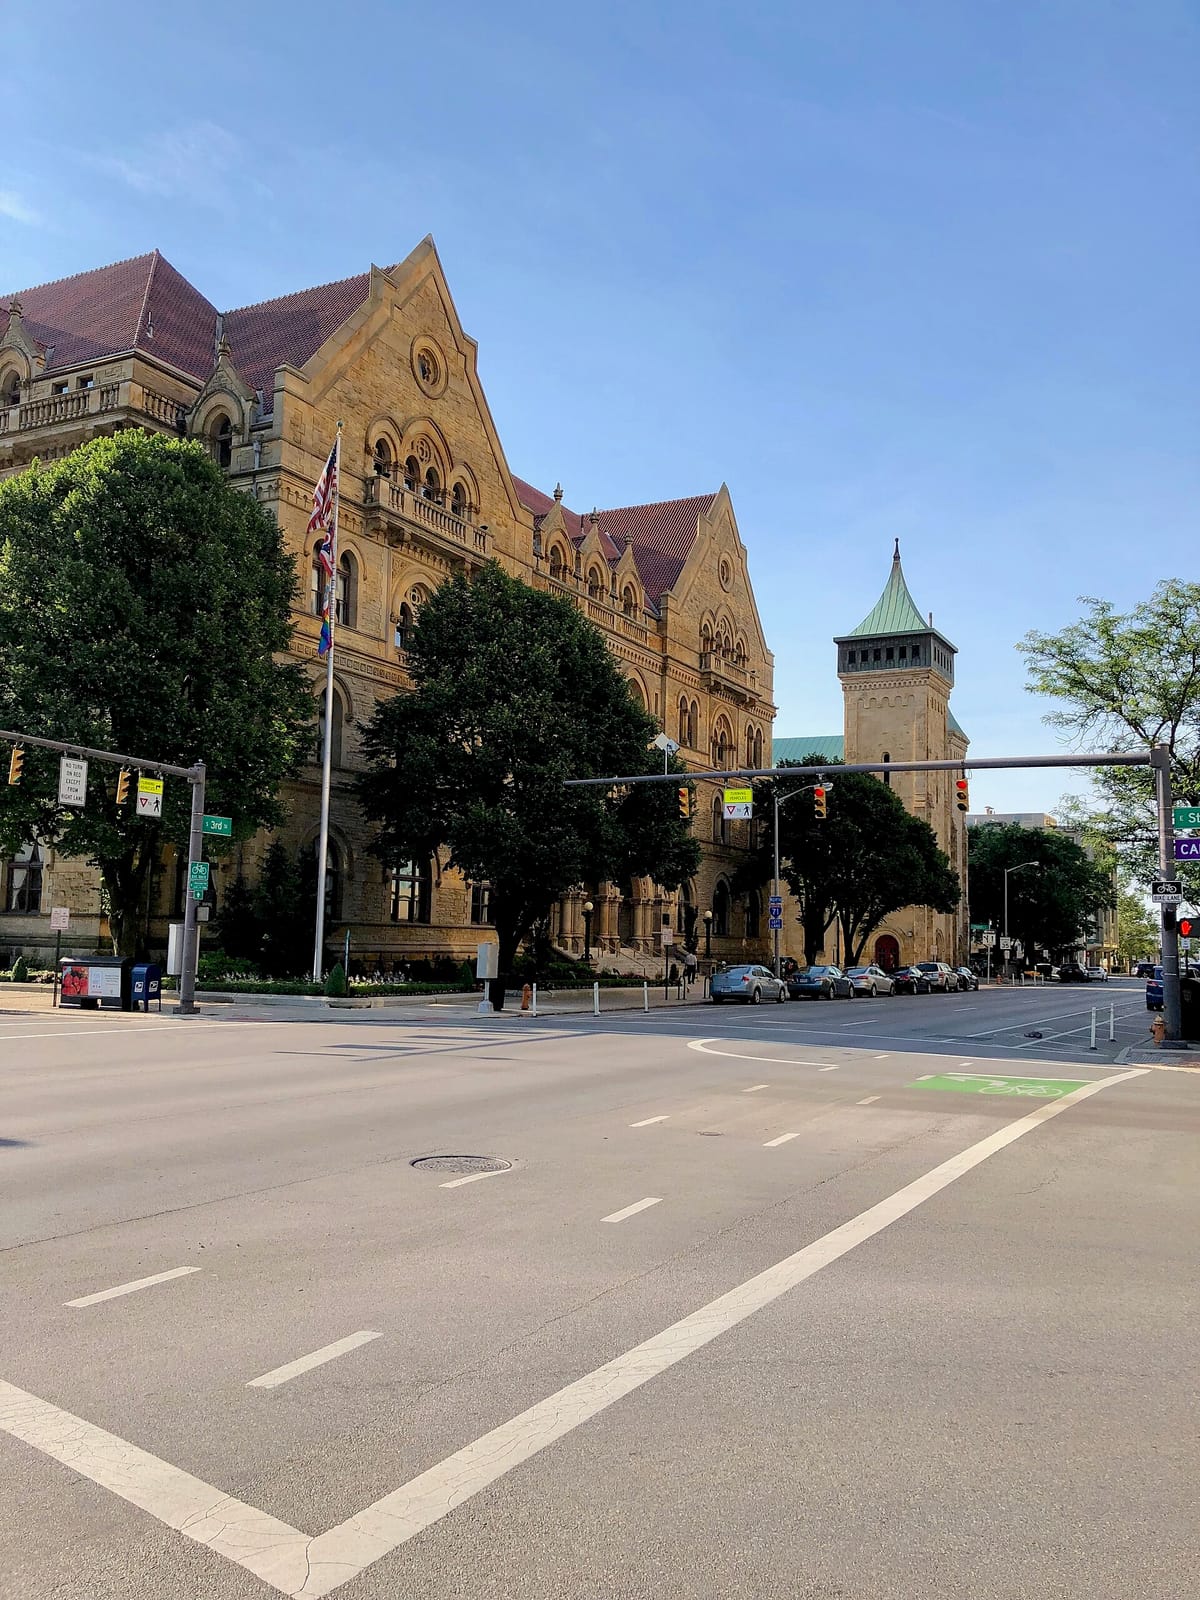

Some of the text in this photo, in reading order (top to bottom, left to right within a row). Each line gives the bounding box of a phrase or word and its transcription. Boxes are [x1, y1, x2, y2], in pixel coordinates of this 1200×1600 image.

[210, 820, 223, 831] 3rd
[1180, 843, 1200, 856] CA
[771, 908, 780, 916] 71
